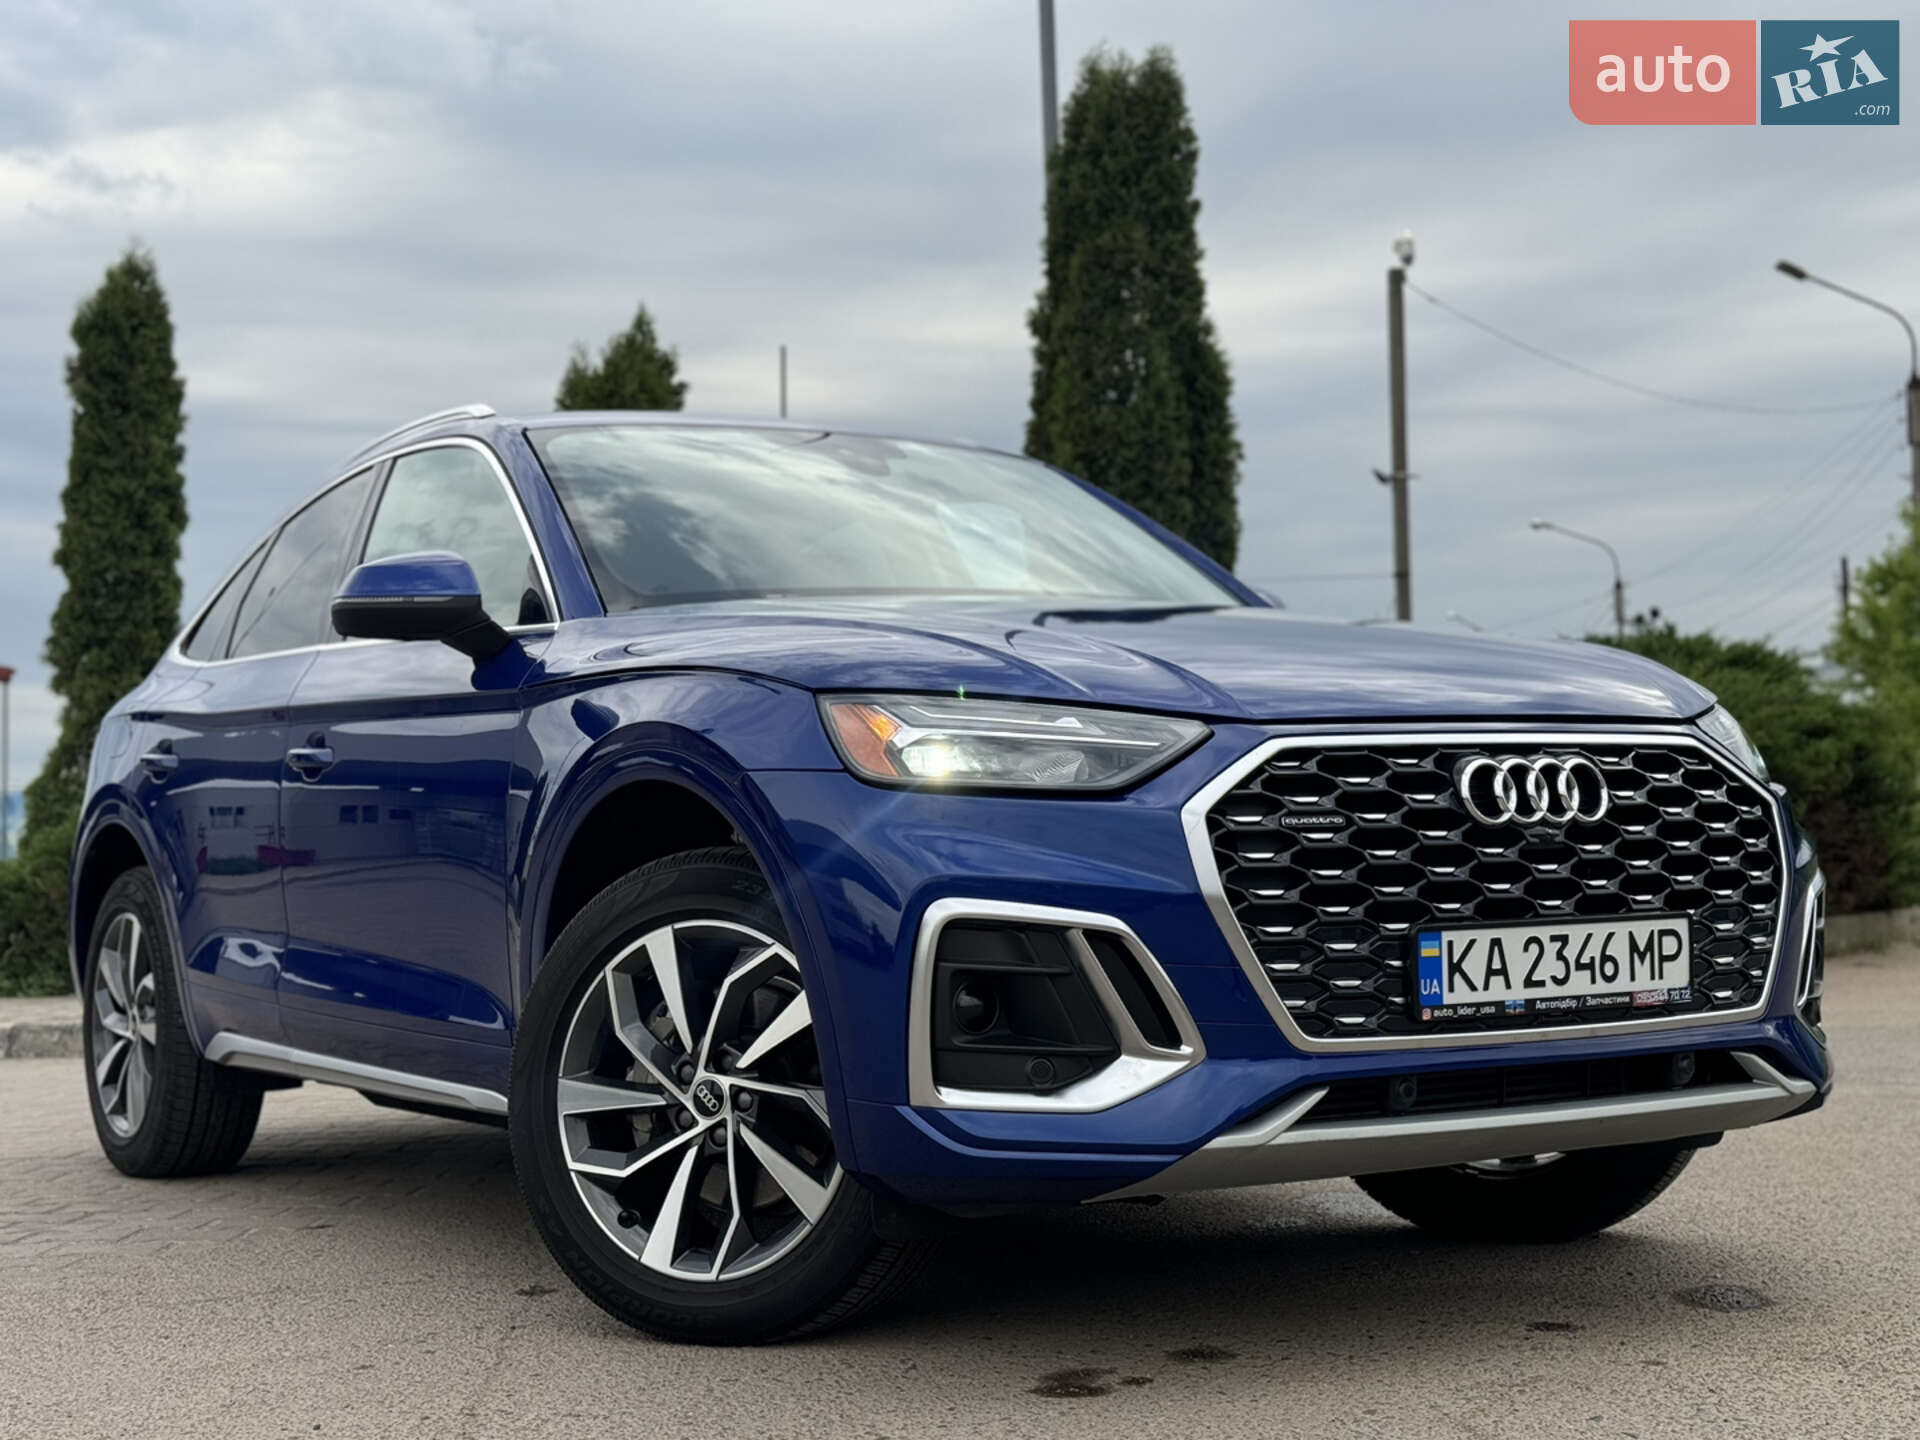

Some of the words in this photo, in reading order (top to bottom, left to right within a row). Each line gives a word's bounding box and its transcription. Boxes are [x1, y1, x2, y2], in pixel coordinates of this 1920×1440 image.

[1447, 937, 1511, 993] KA
[1522, 932, 1619, 989] 2346
[1628, 928, 1682, 982] MP
[1421, 979, 1440, 995] UA
